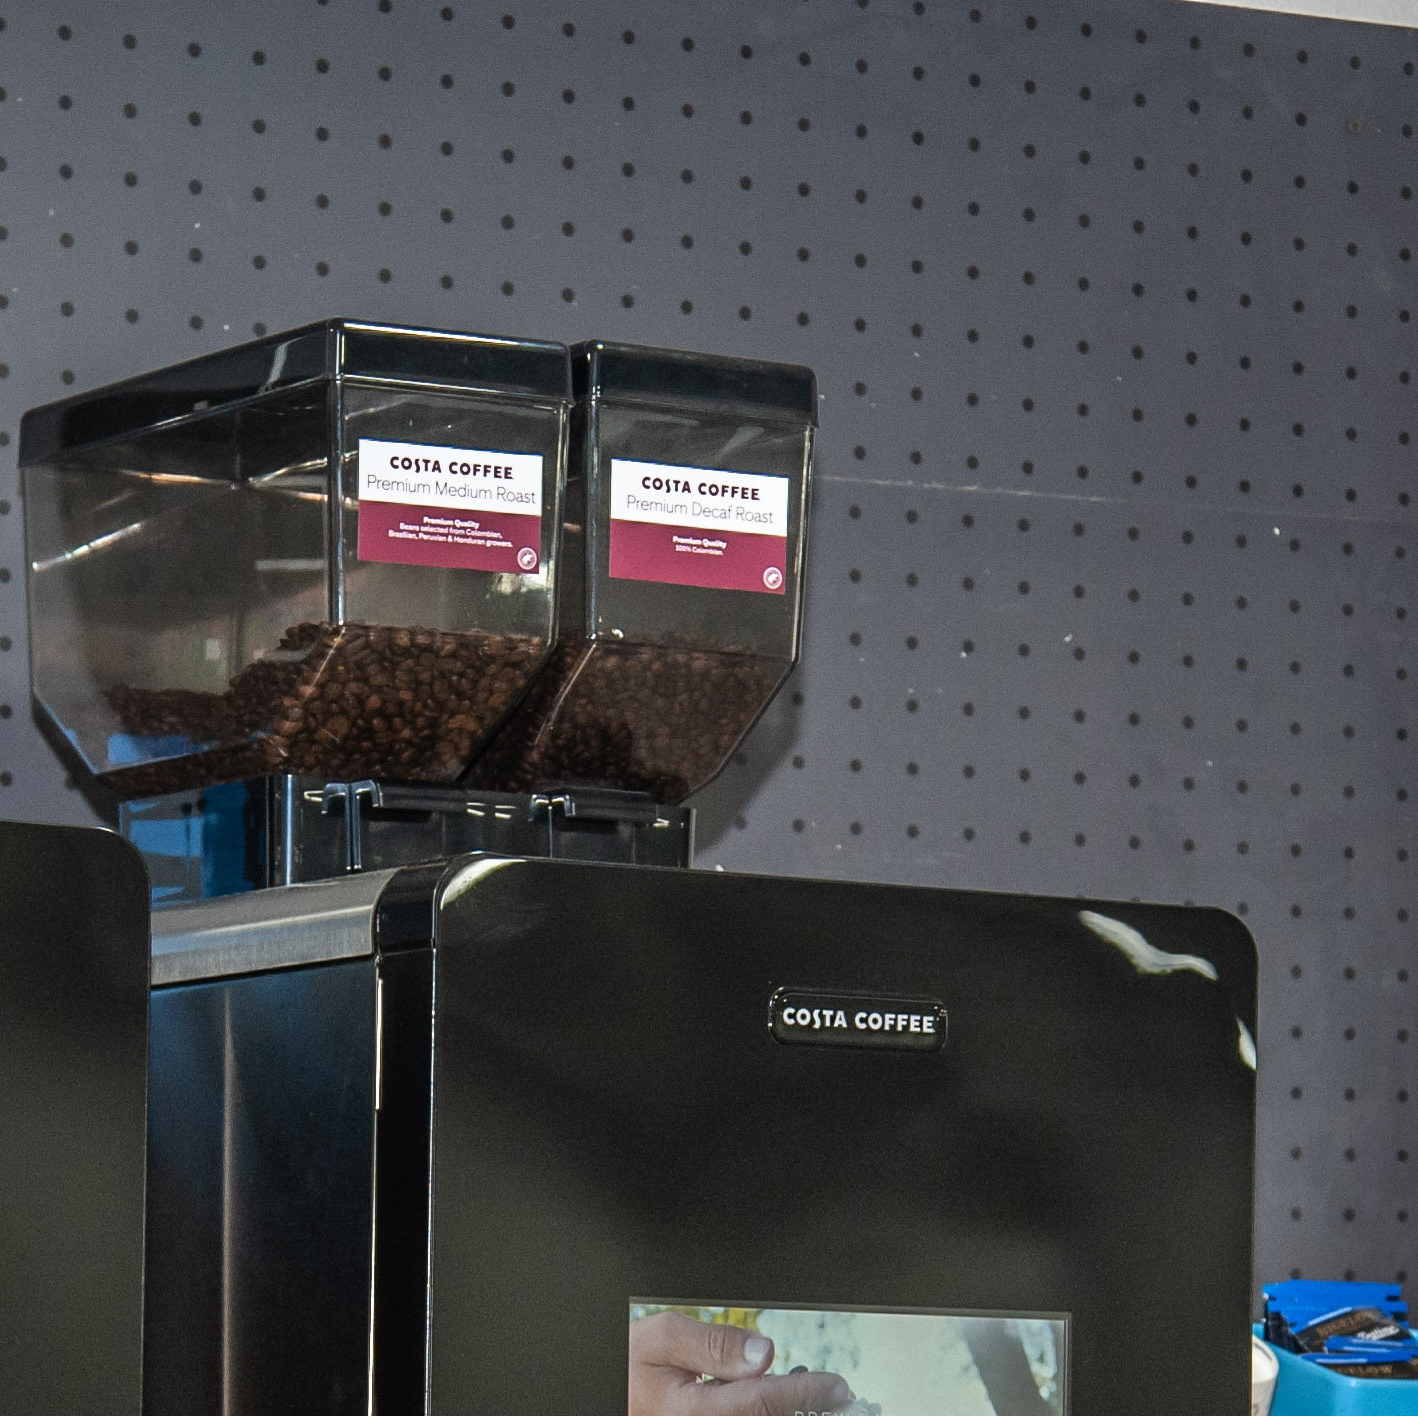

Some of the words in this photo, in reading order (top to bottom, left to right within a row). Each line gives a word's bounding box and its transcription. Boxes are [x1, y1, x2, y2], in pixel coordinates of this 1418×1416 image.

[390, 455, 442, 474] COSTA
[449, 461, 514, 480] COFFEE
[367, 474, 431, 495] Premium
[436, 481, 493, 500] Medium
[497, 485, 536, 504] Roast
[641, 476, 692, 494] COSTA
[698, 482, 761, 501] COFFEE
[627, 494, 688, 515] Premium
[692, 501, 733, 520] Decaf
[736, 506, 773, 524] Roast
[782, 1007, 848, 1029] COSTA
[854, 1011, 936, 1033] COFFEE
